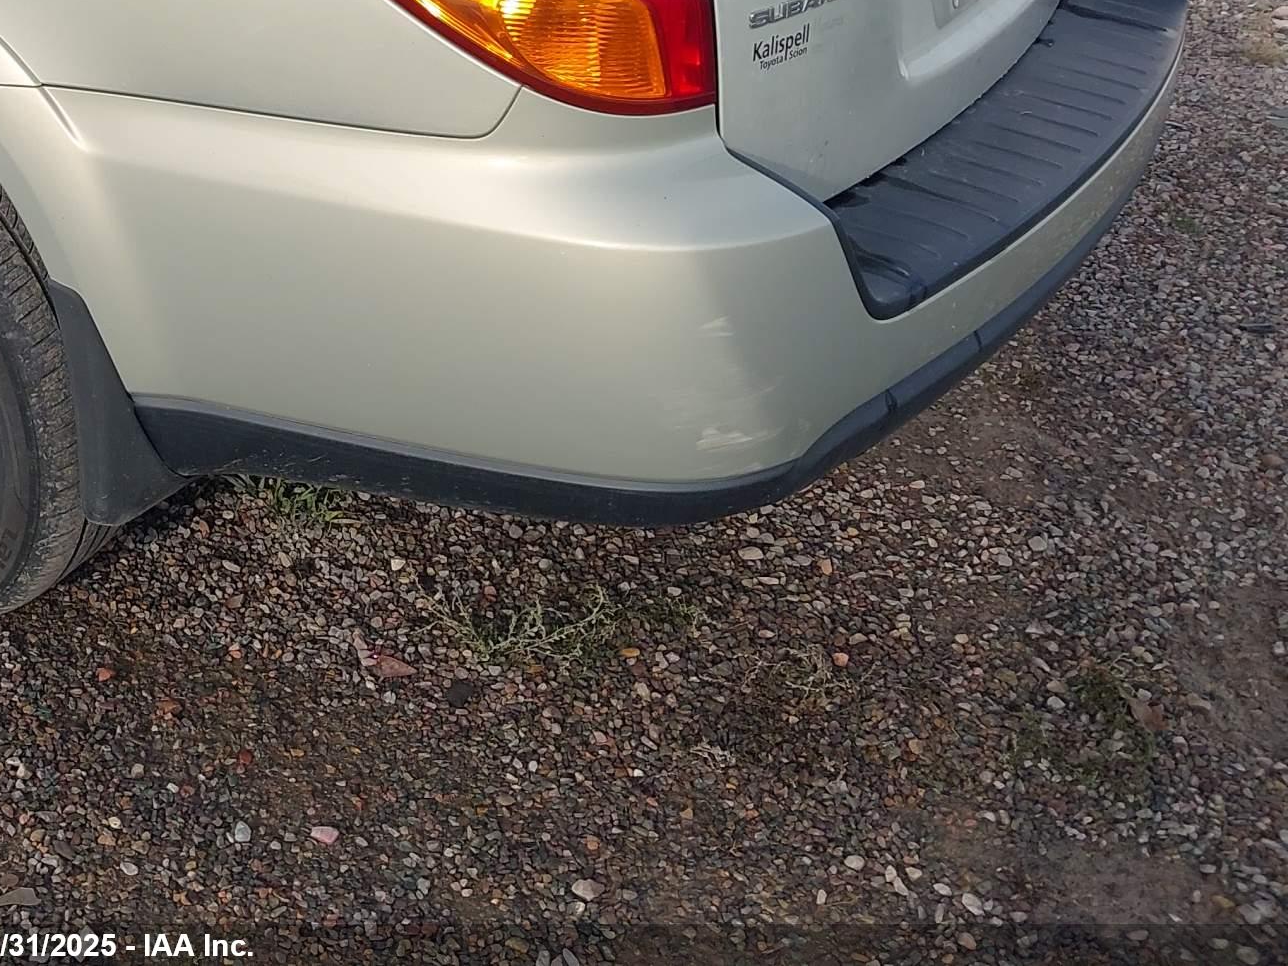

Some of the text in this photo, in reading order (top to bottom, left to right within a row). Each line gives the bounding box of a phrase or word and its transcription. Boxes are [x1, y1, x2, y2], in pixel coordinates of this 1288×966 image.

[753, 24, 810, 62] Kalispell
[760, 47, 808, 70] Toyota Scion
